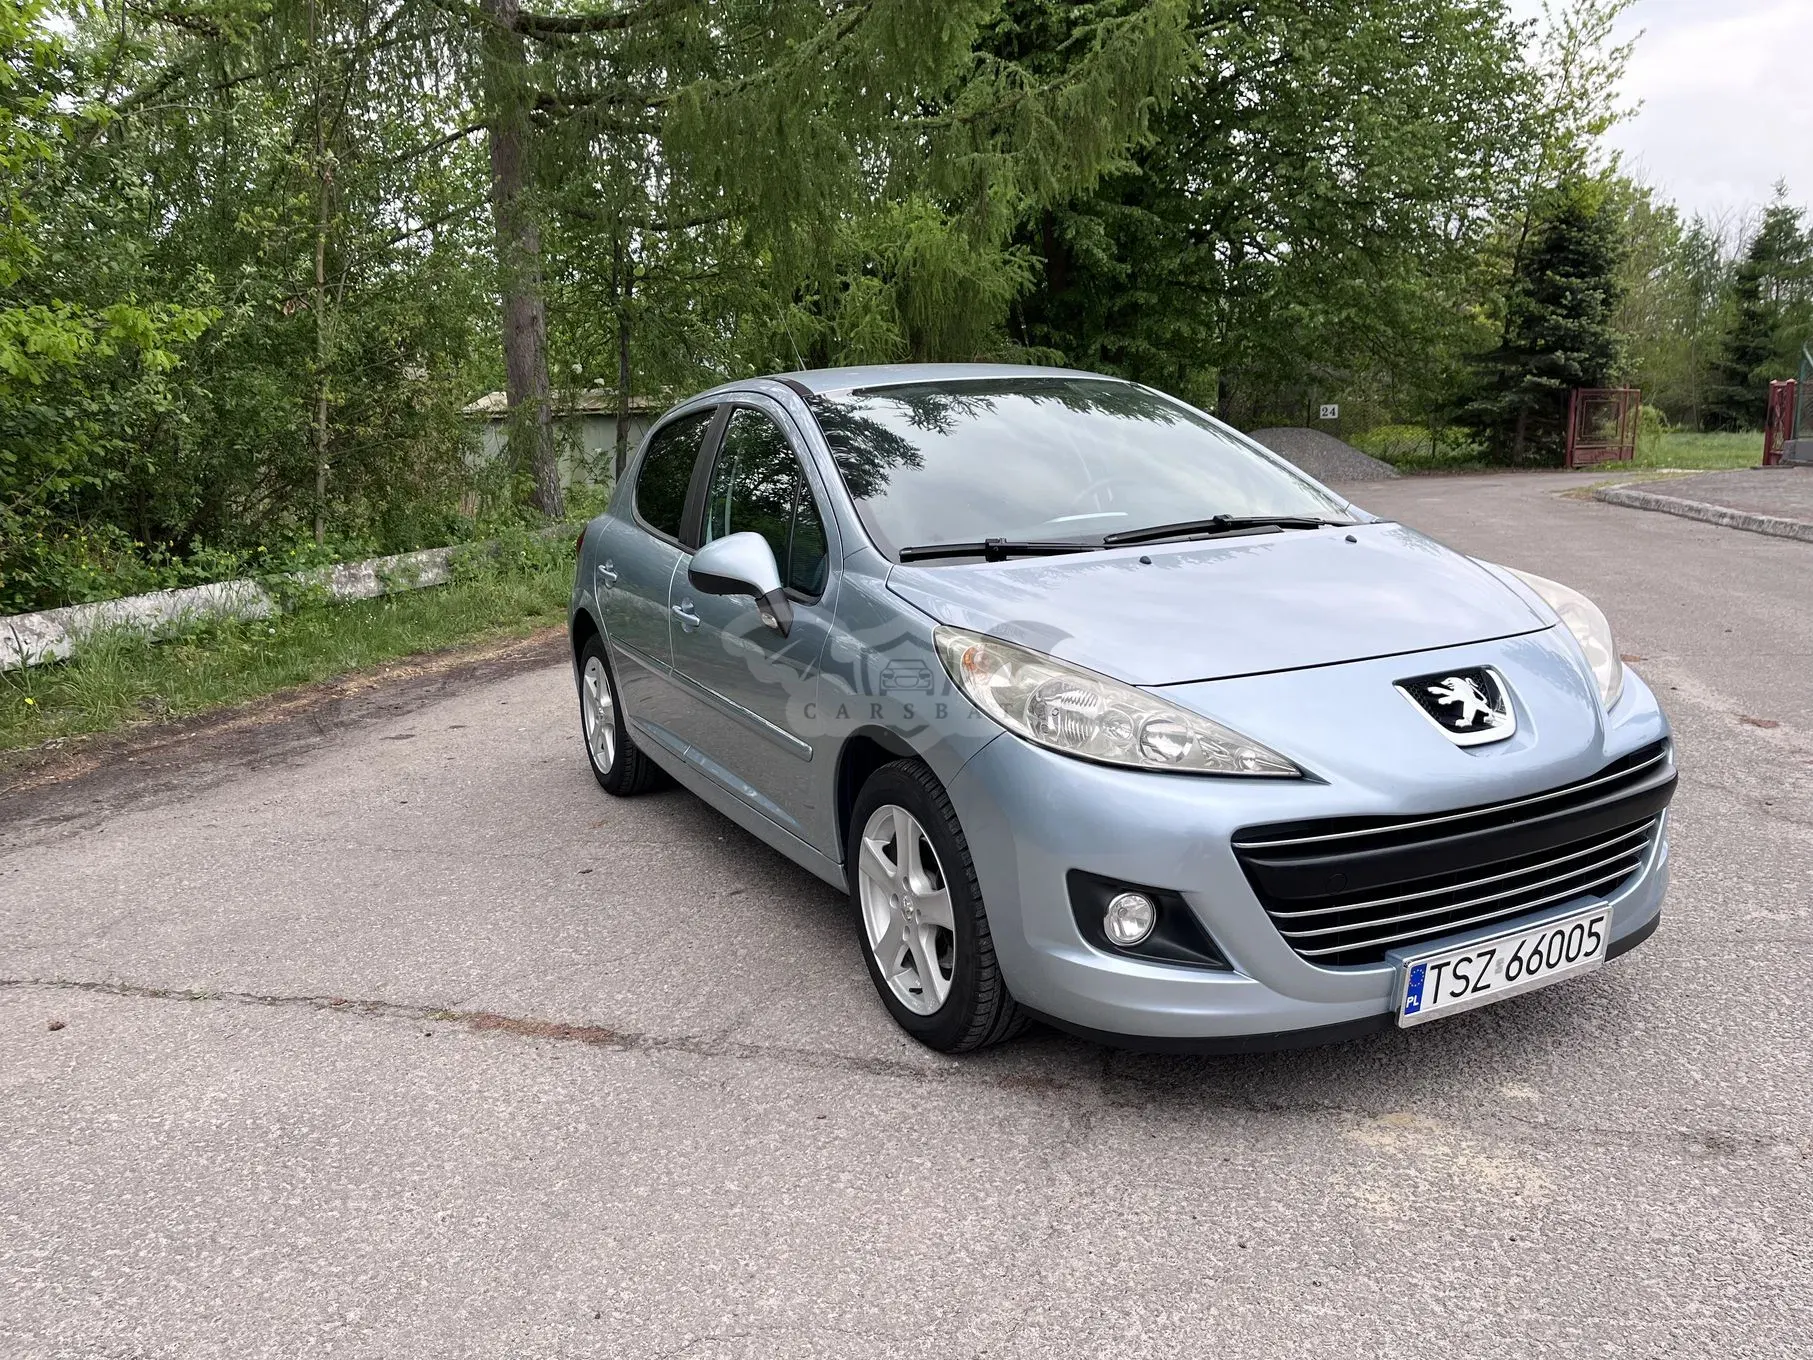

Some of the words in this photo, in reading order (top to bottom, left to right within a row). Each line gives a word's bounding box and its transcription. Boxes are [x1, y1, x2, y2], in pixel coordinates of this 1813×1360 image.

[1321, 406, 1336, 417] 24
[1430, 948, 1497, 1004] TSZ
[1505, 916, 1605, 982] 66005
[1406, 996, 1420, 1009] PL
